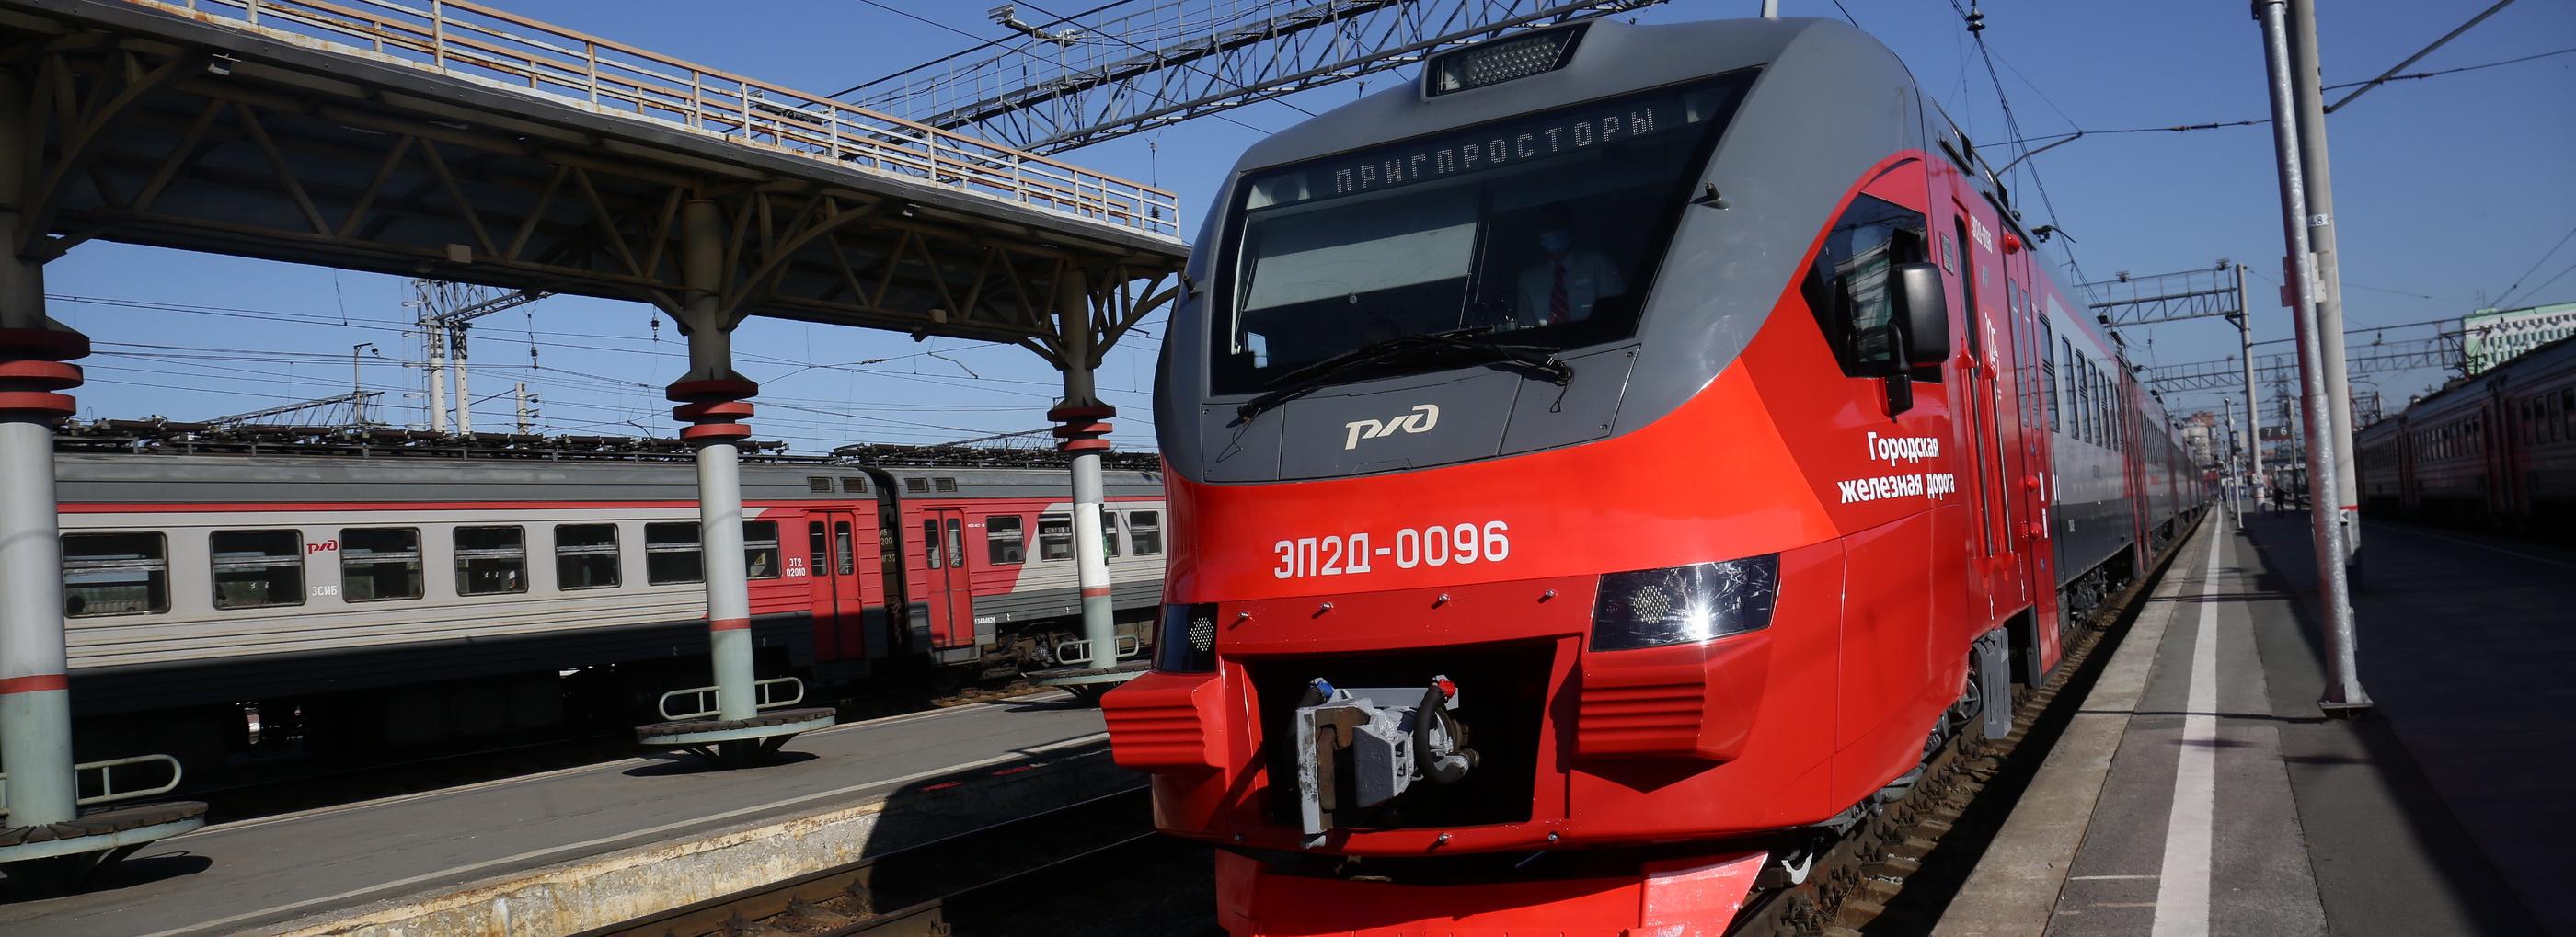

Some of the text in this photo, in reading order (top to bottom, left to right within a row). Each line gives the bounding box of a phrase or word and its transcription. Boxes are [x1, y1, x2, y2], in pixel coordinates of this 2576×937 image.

[1335, 108, 1654, 194] ПРИГПРОСТОРЫ
[1867, 431, 1940, 467] Городская
[1837, 473, 1956, 504] железная дорога
[1273, 520, 1510, 580] ЭП2Д-0096
[311, 585, 339, 597] ЗСИБ
